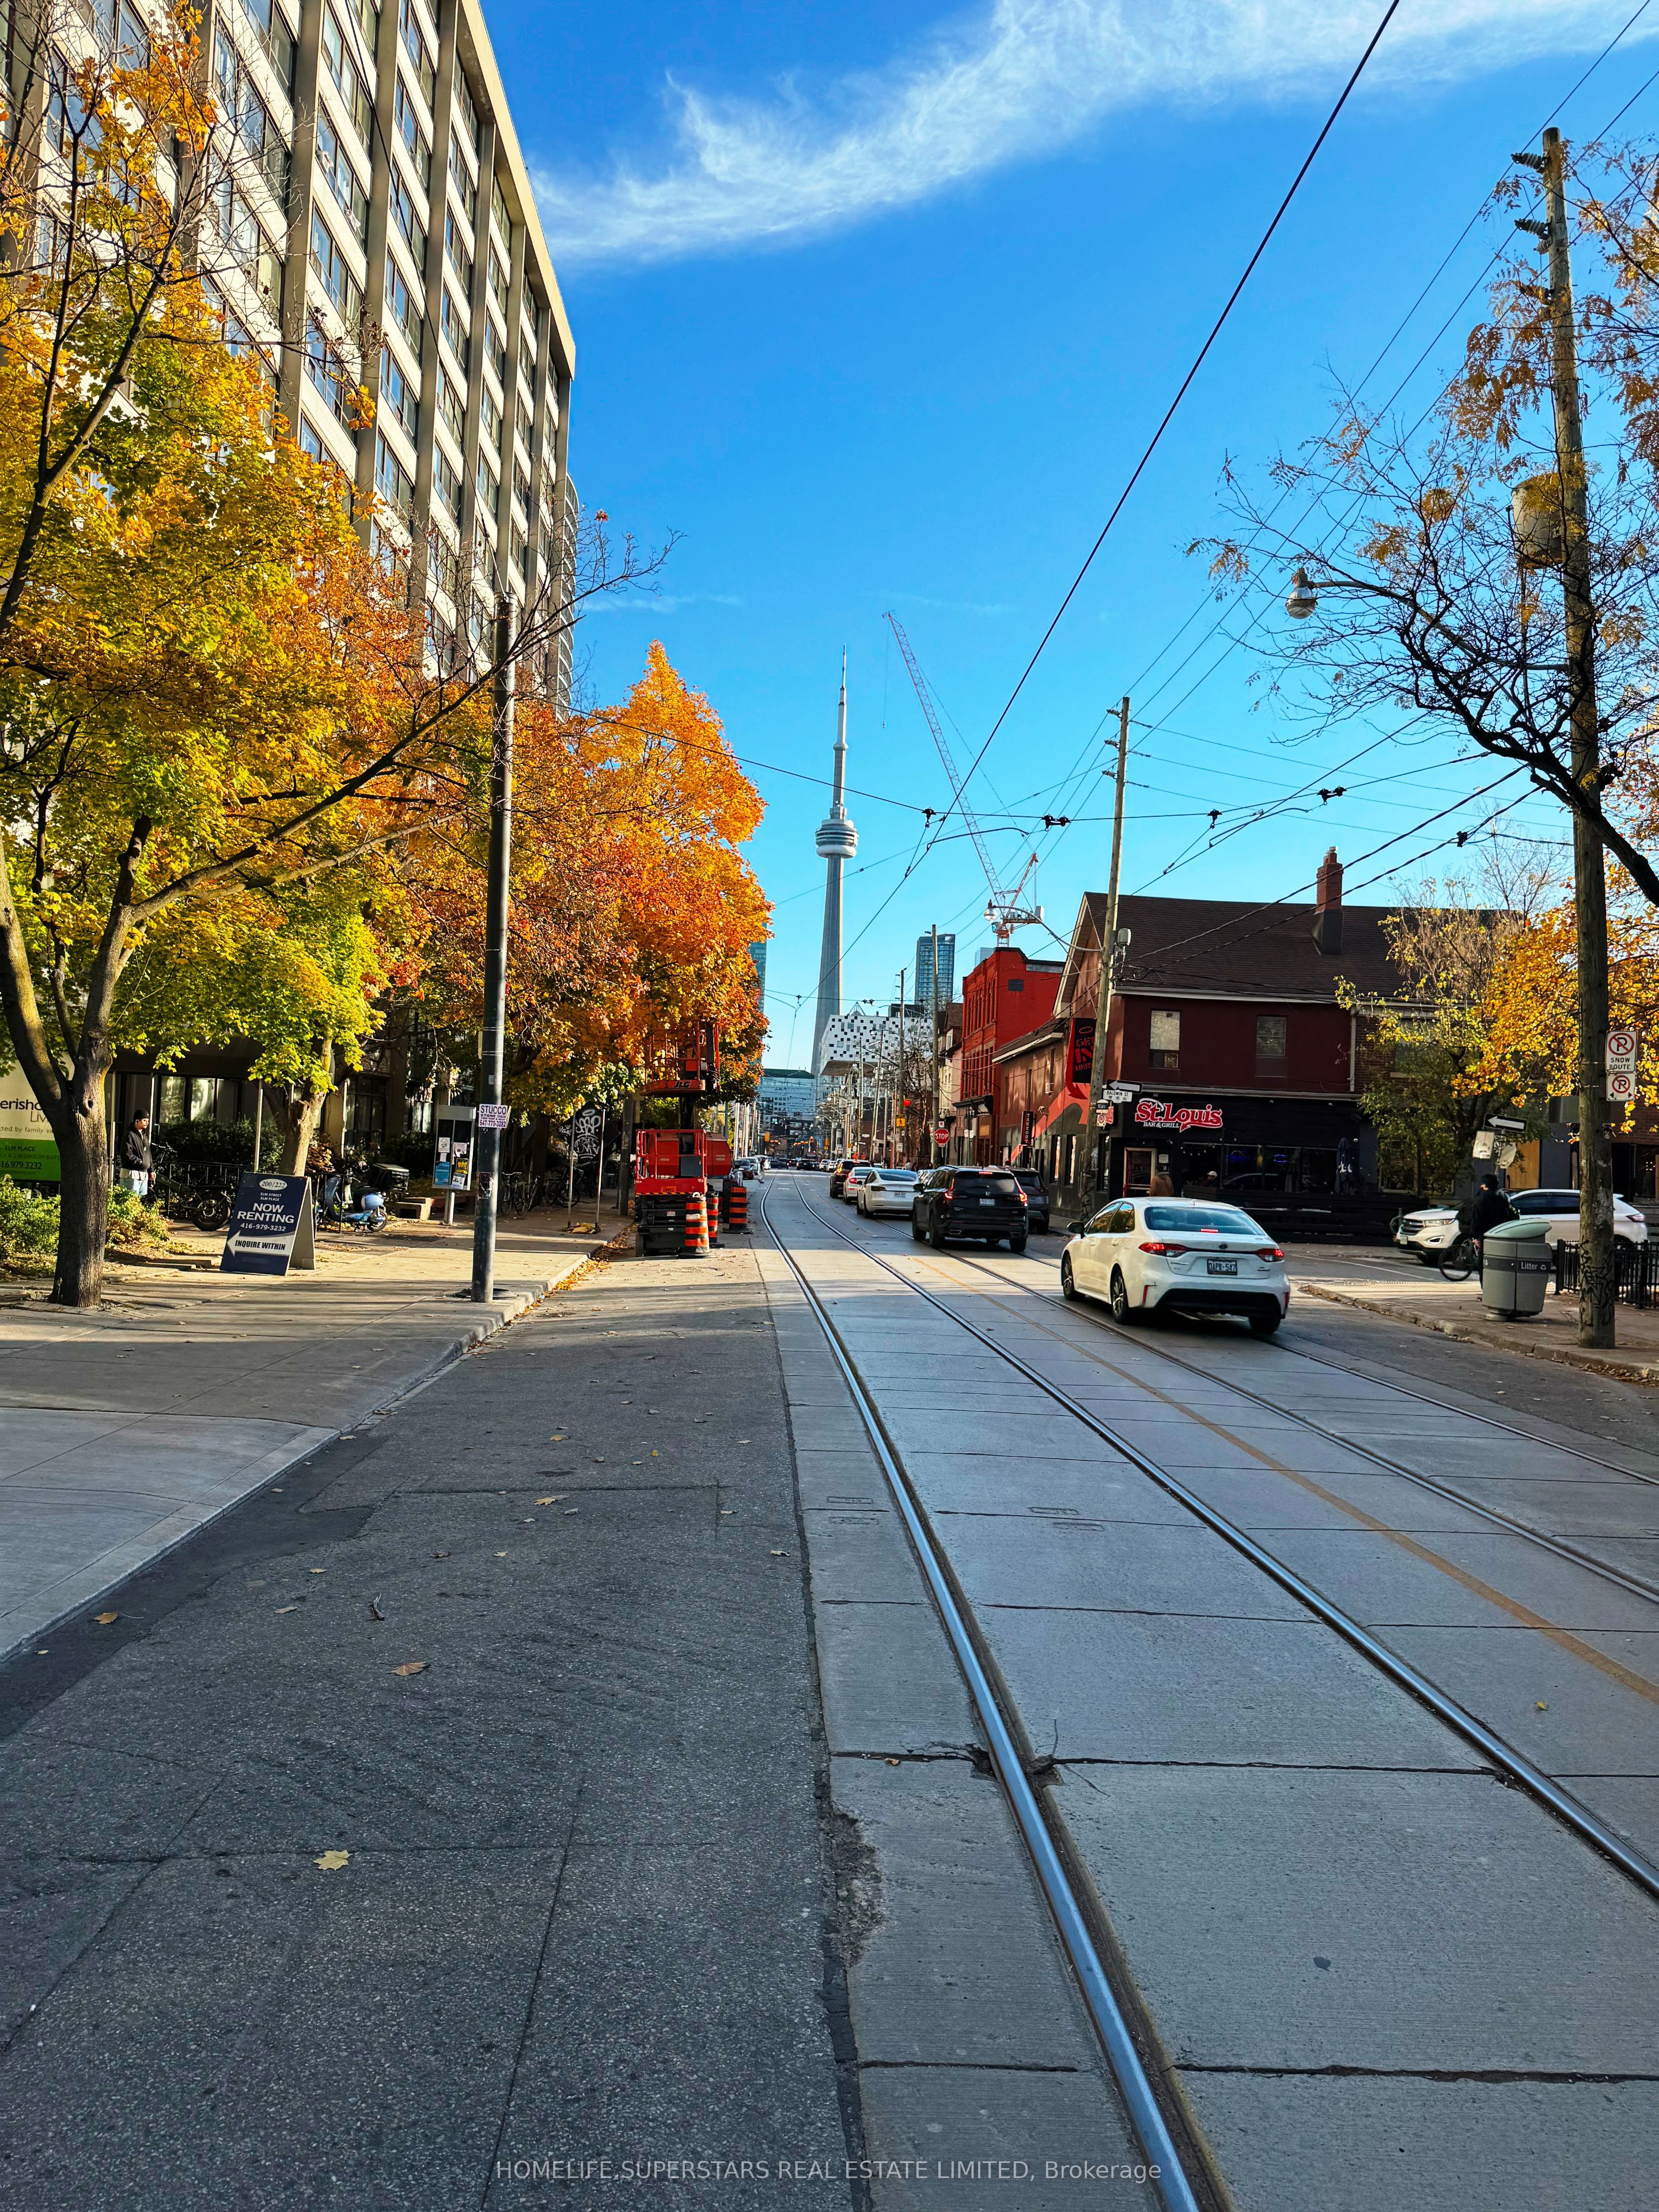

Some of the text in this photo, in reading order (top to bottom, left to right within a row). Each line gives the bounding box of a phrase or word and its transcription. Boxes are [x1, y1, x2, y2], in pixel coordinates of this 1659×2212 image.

[1075, 1062, 1092, 1071] HER
[673, 1081, 691, 1089] JLG
[0, 1098, 42, 1111] erisho
[480, 1105, 506, 1115] STUCCO
[30, 1111, 48, 1122] Liv
[0, 1161, 42, 1170] 16.979.3232
[253, 1203, 285, 1213] NOW
[237, 1211, 295, 1224] RENTING
[234, 1240, 286, 1251] INQUIRE WITHIN
[1521, 1262, 1537, 1270] Litter
